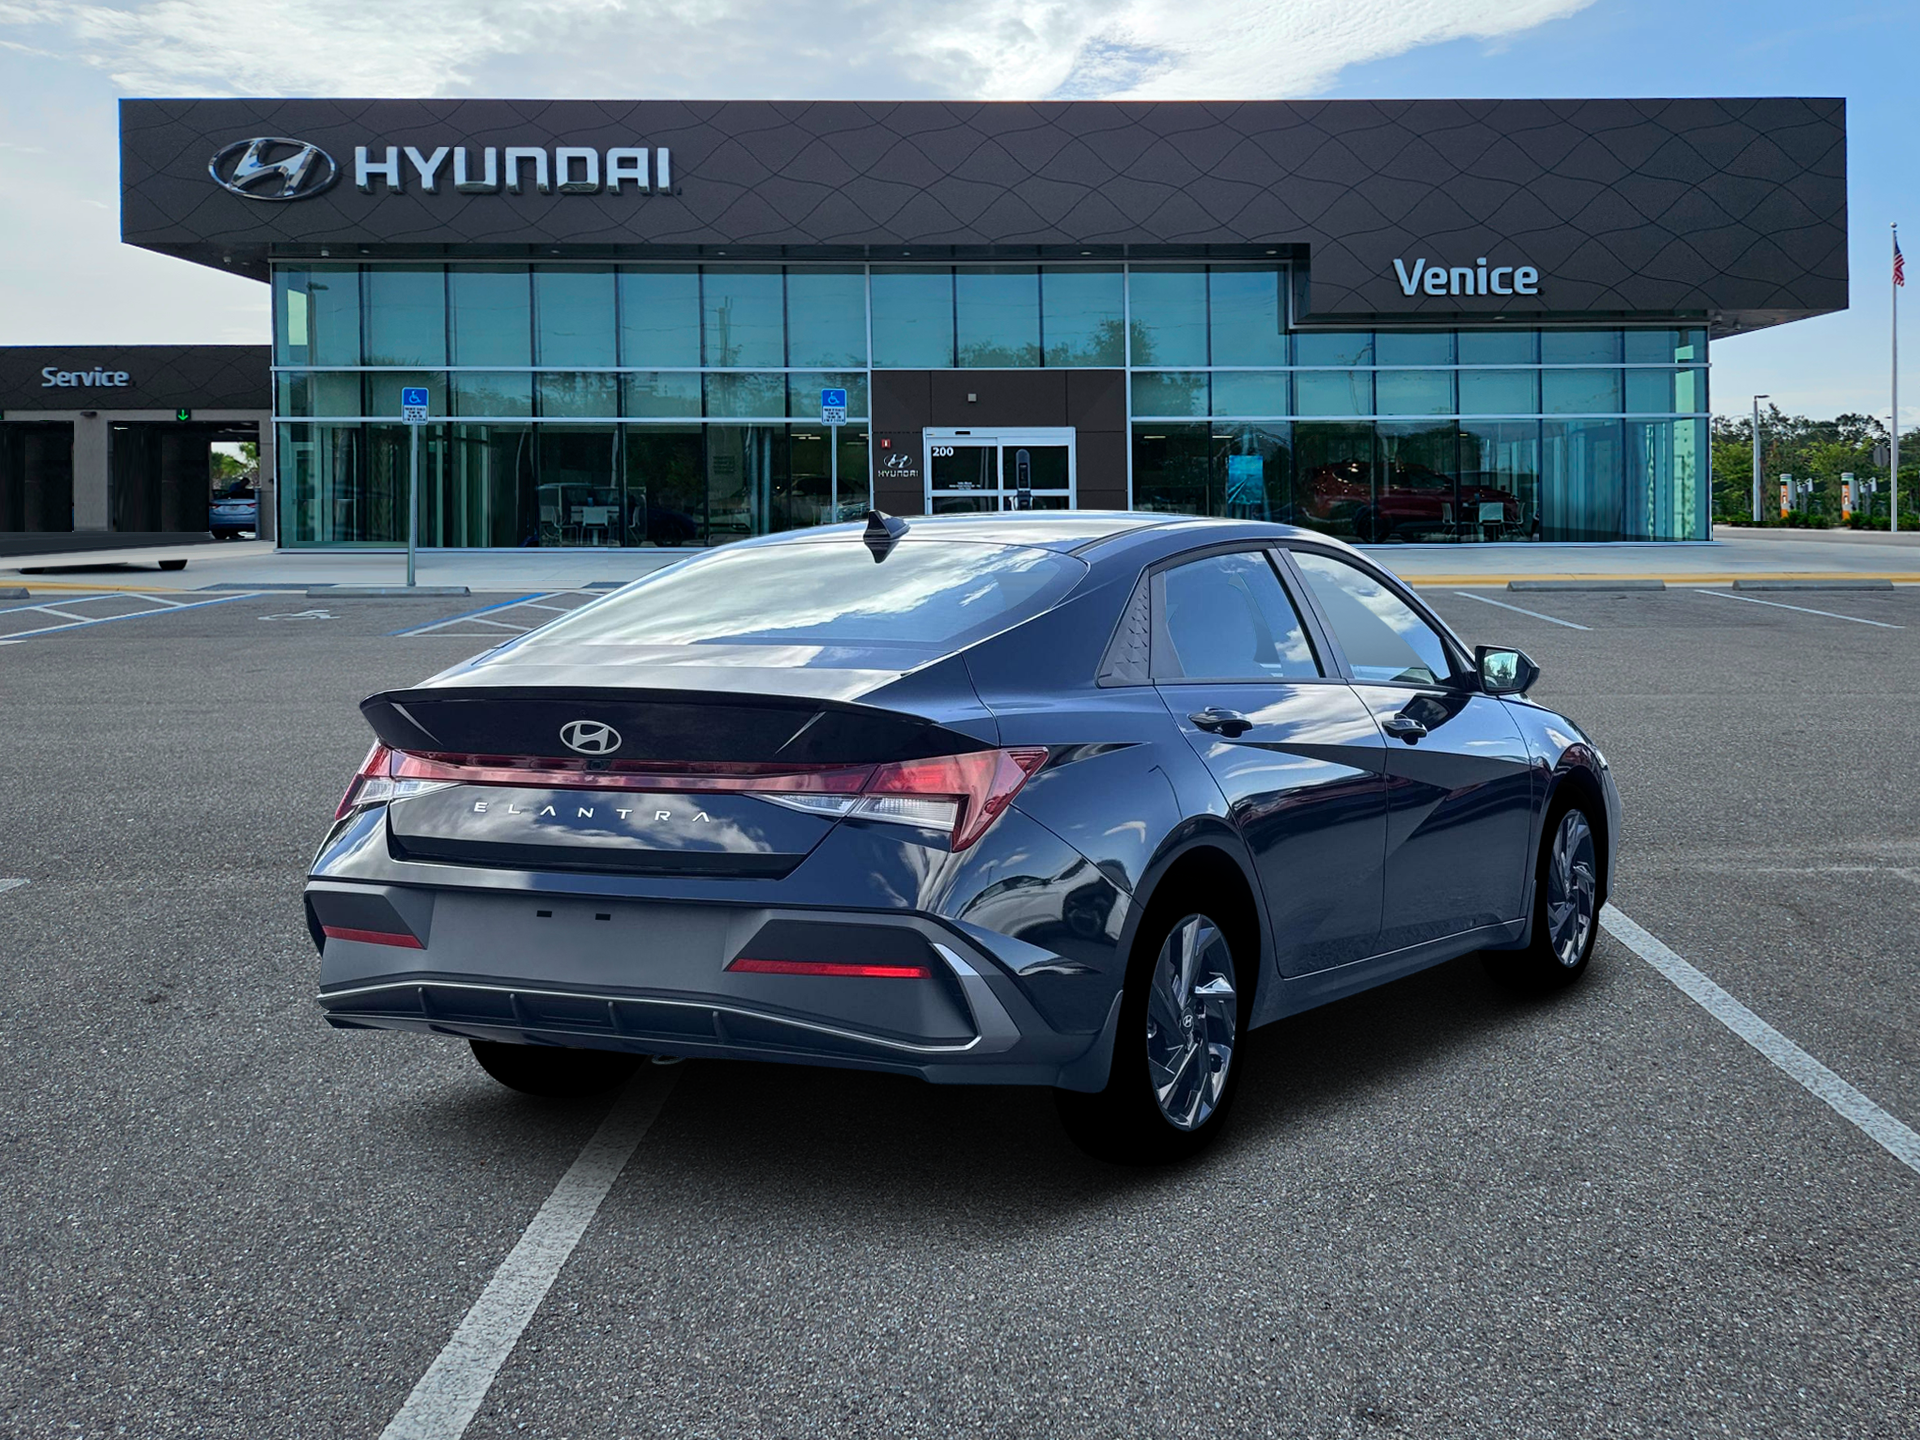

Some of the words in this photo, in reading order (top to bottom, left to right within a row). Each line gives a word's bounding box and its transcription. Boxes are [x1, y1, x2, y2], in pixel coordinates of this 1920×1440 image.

[354, 146, 671, 194] HYUNDAI
[1393, 257, 1538, 295] Venice
[41, 366, 130, 387] Service
[932, 446, 954, 457] 200
[474, 802, 710, 822] ELANTRA
